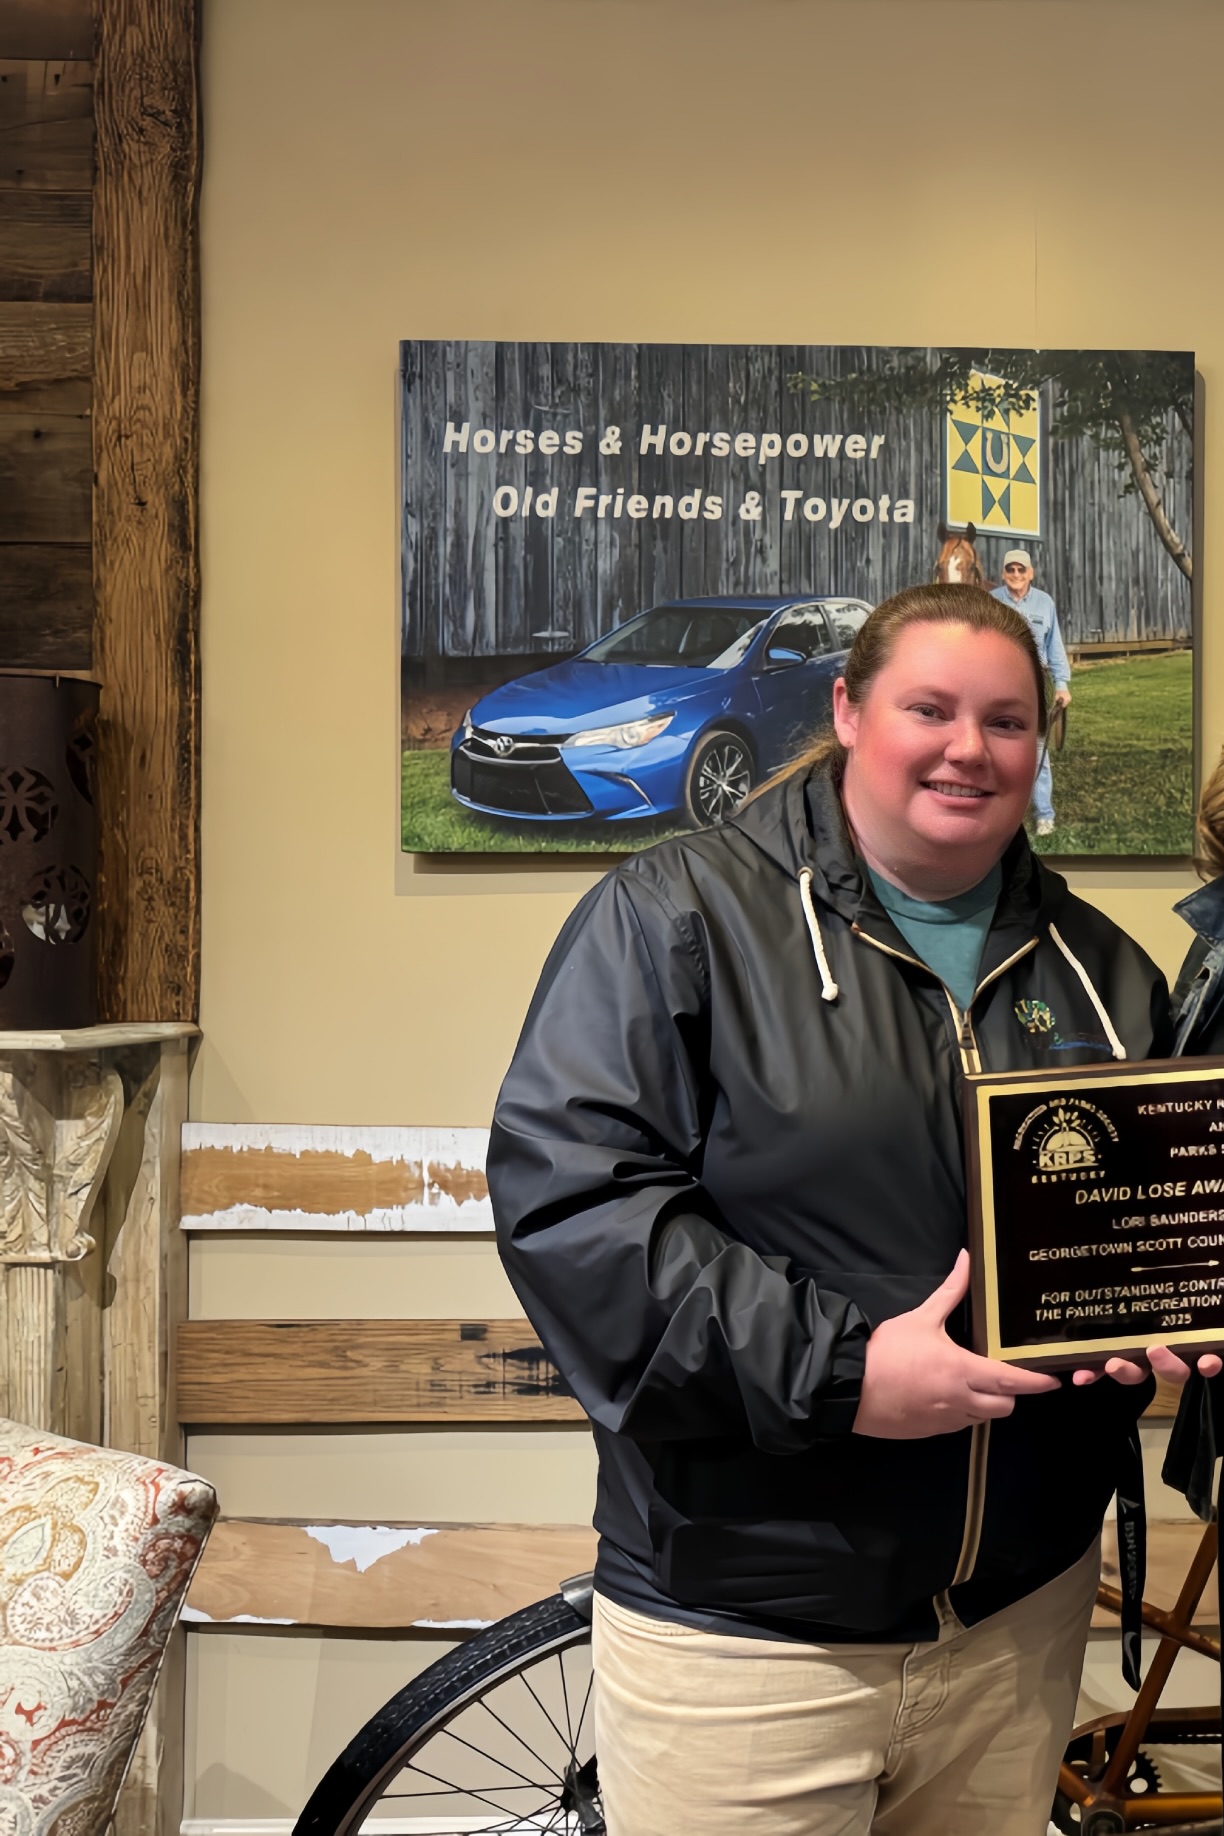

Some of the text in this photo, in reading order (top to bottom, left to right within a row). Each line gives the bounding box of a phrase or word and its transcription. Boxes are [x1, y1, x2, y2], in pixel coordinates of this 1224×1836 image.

[443, 422, 885, 464] Horses & Horsepower
[492, 485, 915, 529] Old Friends & Toyota
[1137, 1100, 1212, 1115] KENTUCKY
[1039, 1150, 1096, 1167] KRPS
[1170, 1144, 1217, 1158] PARKS
[1075, 1187, 1131, 1205] DAVID
[1137, 1181, 1187, 1200] LOSE
[1112, 1216, 1145, 1229] LORI
[1029, 1241, 1133, 1261] GEORGETOWN
[1136, 1238, 1183, 1252] SCOTT
[1041, 1291, 1070, 1304] FOR
[1075, 1282, 1174, 1301] OUTSTANDING
[1035, 1308, 1061, 1321] THE
[1066, 1302, 1113, 1319] PARKS
[1117, 1302, 1127, 1314] &
[1131, 1294, 1222, 1313] RECREATION
[1161, 1313, 1192, 1327] 2025
